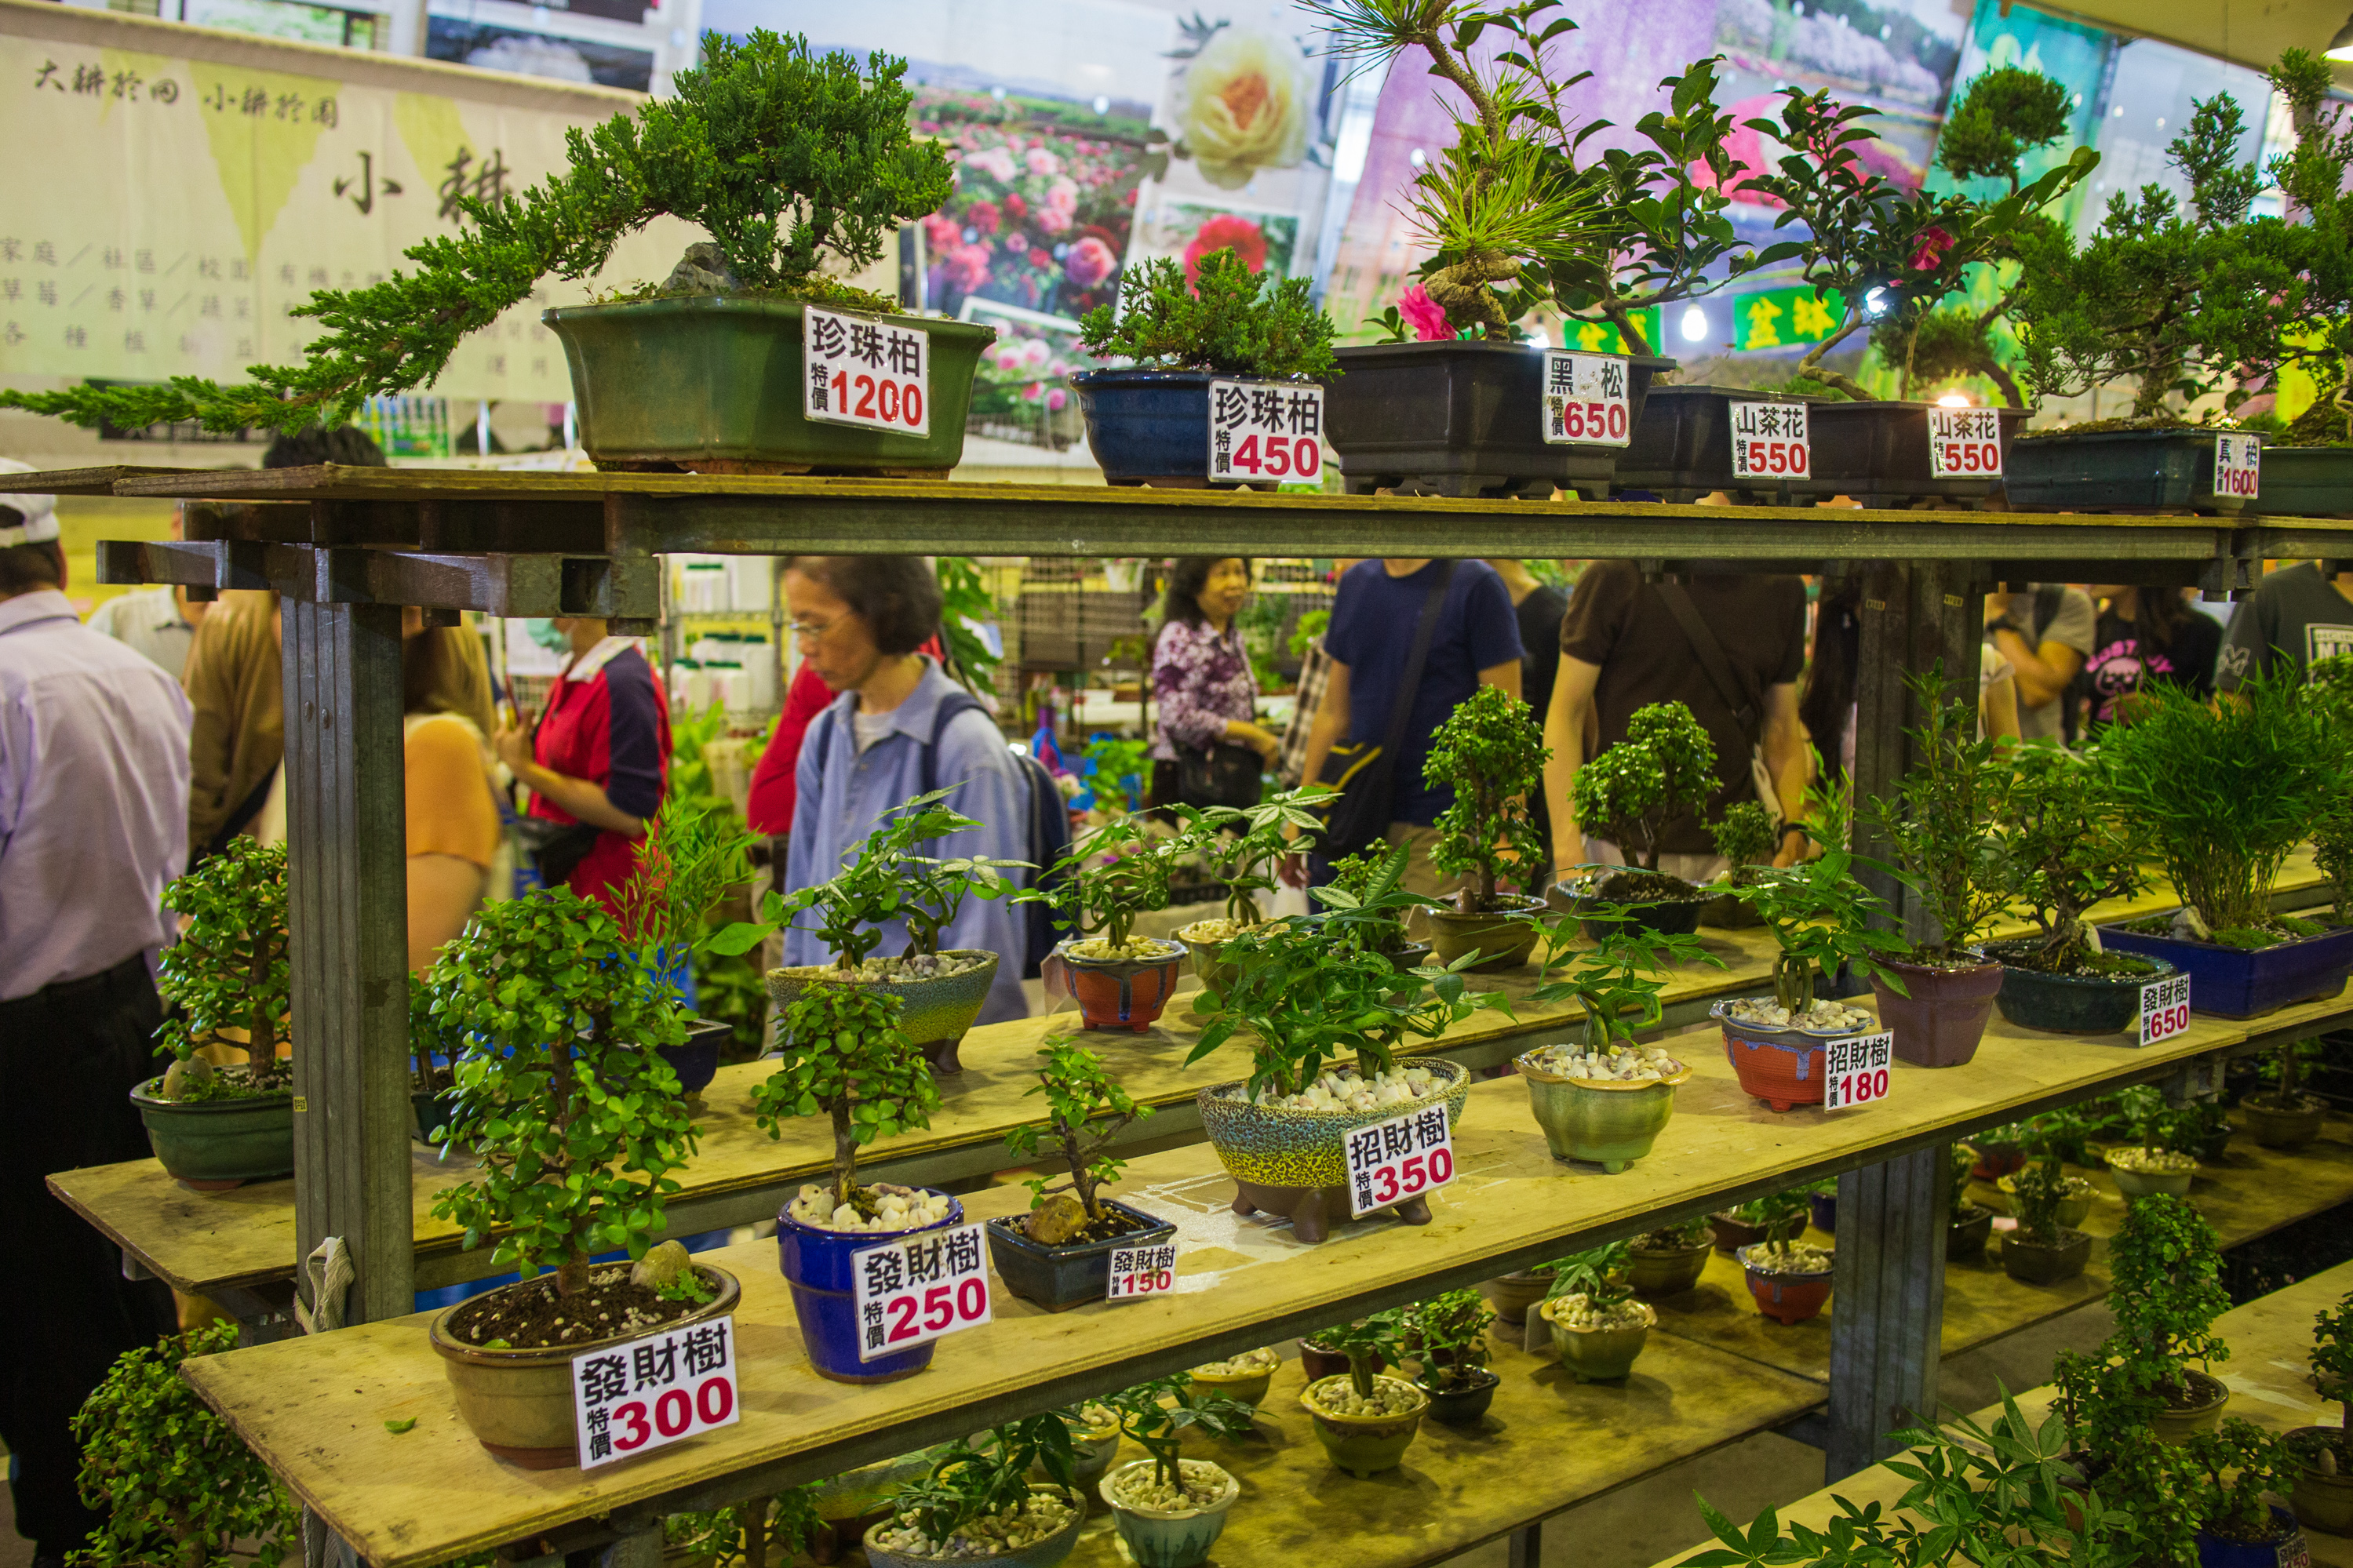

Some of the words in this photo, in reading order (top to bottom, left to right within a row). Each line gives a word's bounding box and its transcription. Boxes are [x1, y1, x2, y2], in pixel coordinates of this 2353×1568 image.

[812, 315, 920, 377] 珍珠柏
[811, 362, 829, 412] 特價
[832, 370, 922, 426] 1200
[1215, 387, 1319, 435] 珍珠柏
[1551, 396, 1564, 435] 特價
[1564, 402, 1626, 438] 650
[1736, 406, 1803, 438] 山茶花
[1932, 412, 1995, 439] 山茶花
[1215, 430, 1230, 474] 特價
[1233, 435, 1319, 477] 450
[1736, 438, 1747, 472] 特價
[1749, 442, 1805, 473] 550
[1946, 443, 1998, 471] 550
[2224, 467, 2257, 495] 1600
[2144, 977, 2188, 1013] 發財樹
[2151, 1005, 2188, 1038] 650
[1828, 1036, 1889, 1074] 招財樹
[1829, 1076, 1838, 1107] 特價
[1841, 1069, 1888, 1104] 180
[1350, 1108, 1444, 1171] 招財樹
[1355, 1171, 1373, 1210] 特價
[1374, 1148, 1452, 1202] 350
[864, 1228, 979, 1297] 發財樹
[1115, 1246, 1175, 1272] 發財樹
[1122, 1271, 1171, 1293] 150
[864, 1301, 884, 1350] 特價
[887, 1277, 986, 1343] 250
[580, 1322, 727, 1407] 發財樹
[587, 1406, 612, 1461] 特價
[612, 1377, 733, 1450] 300
